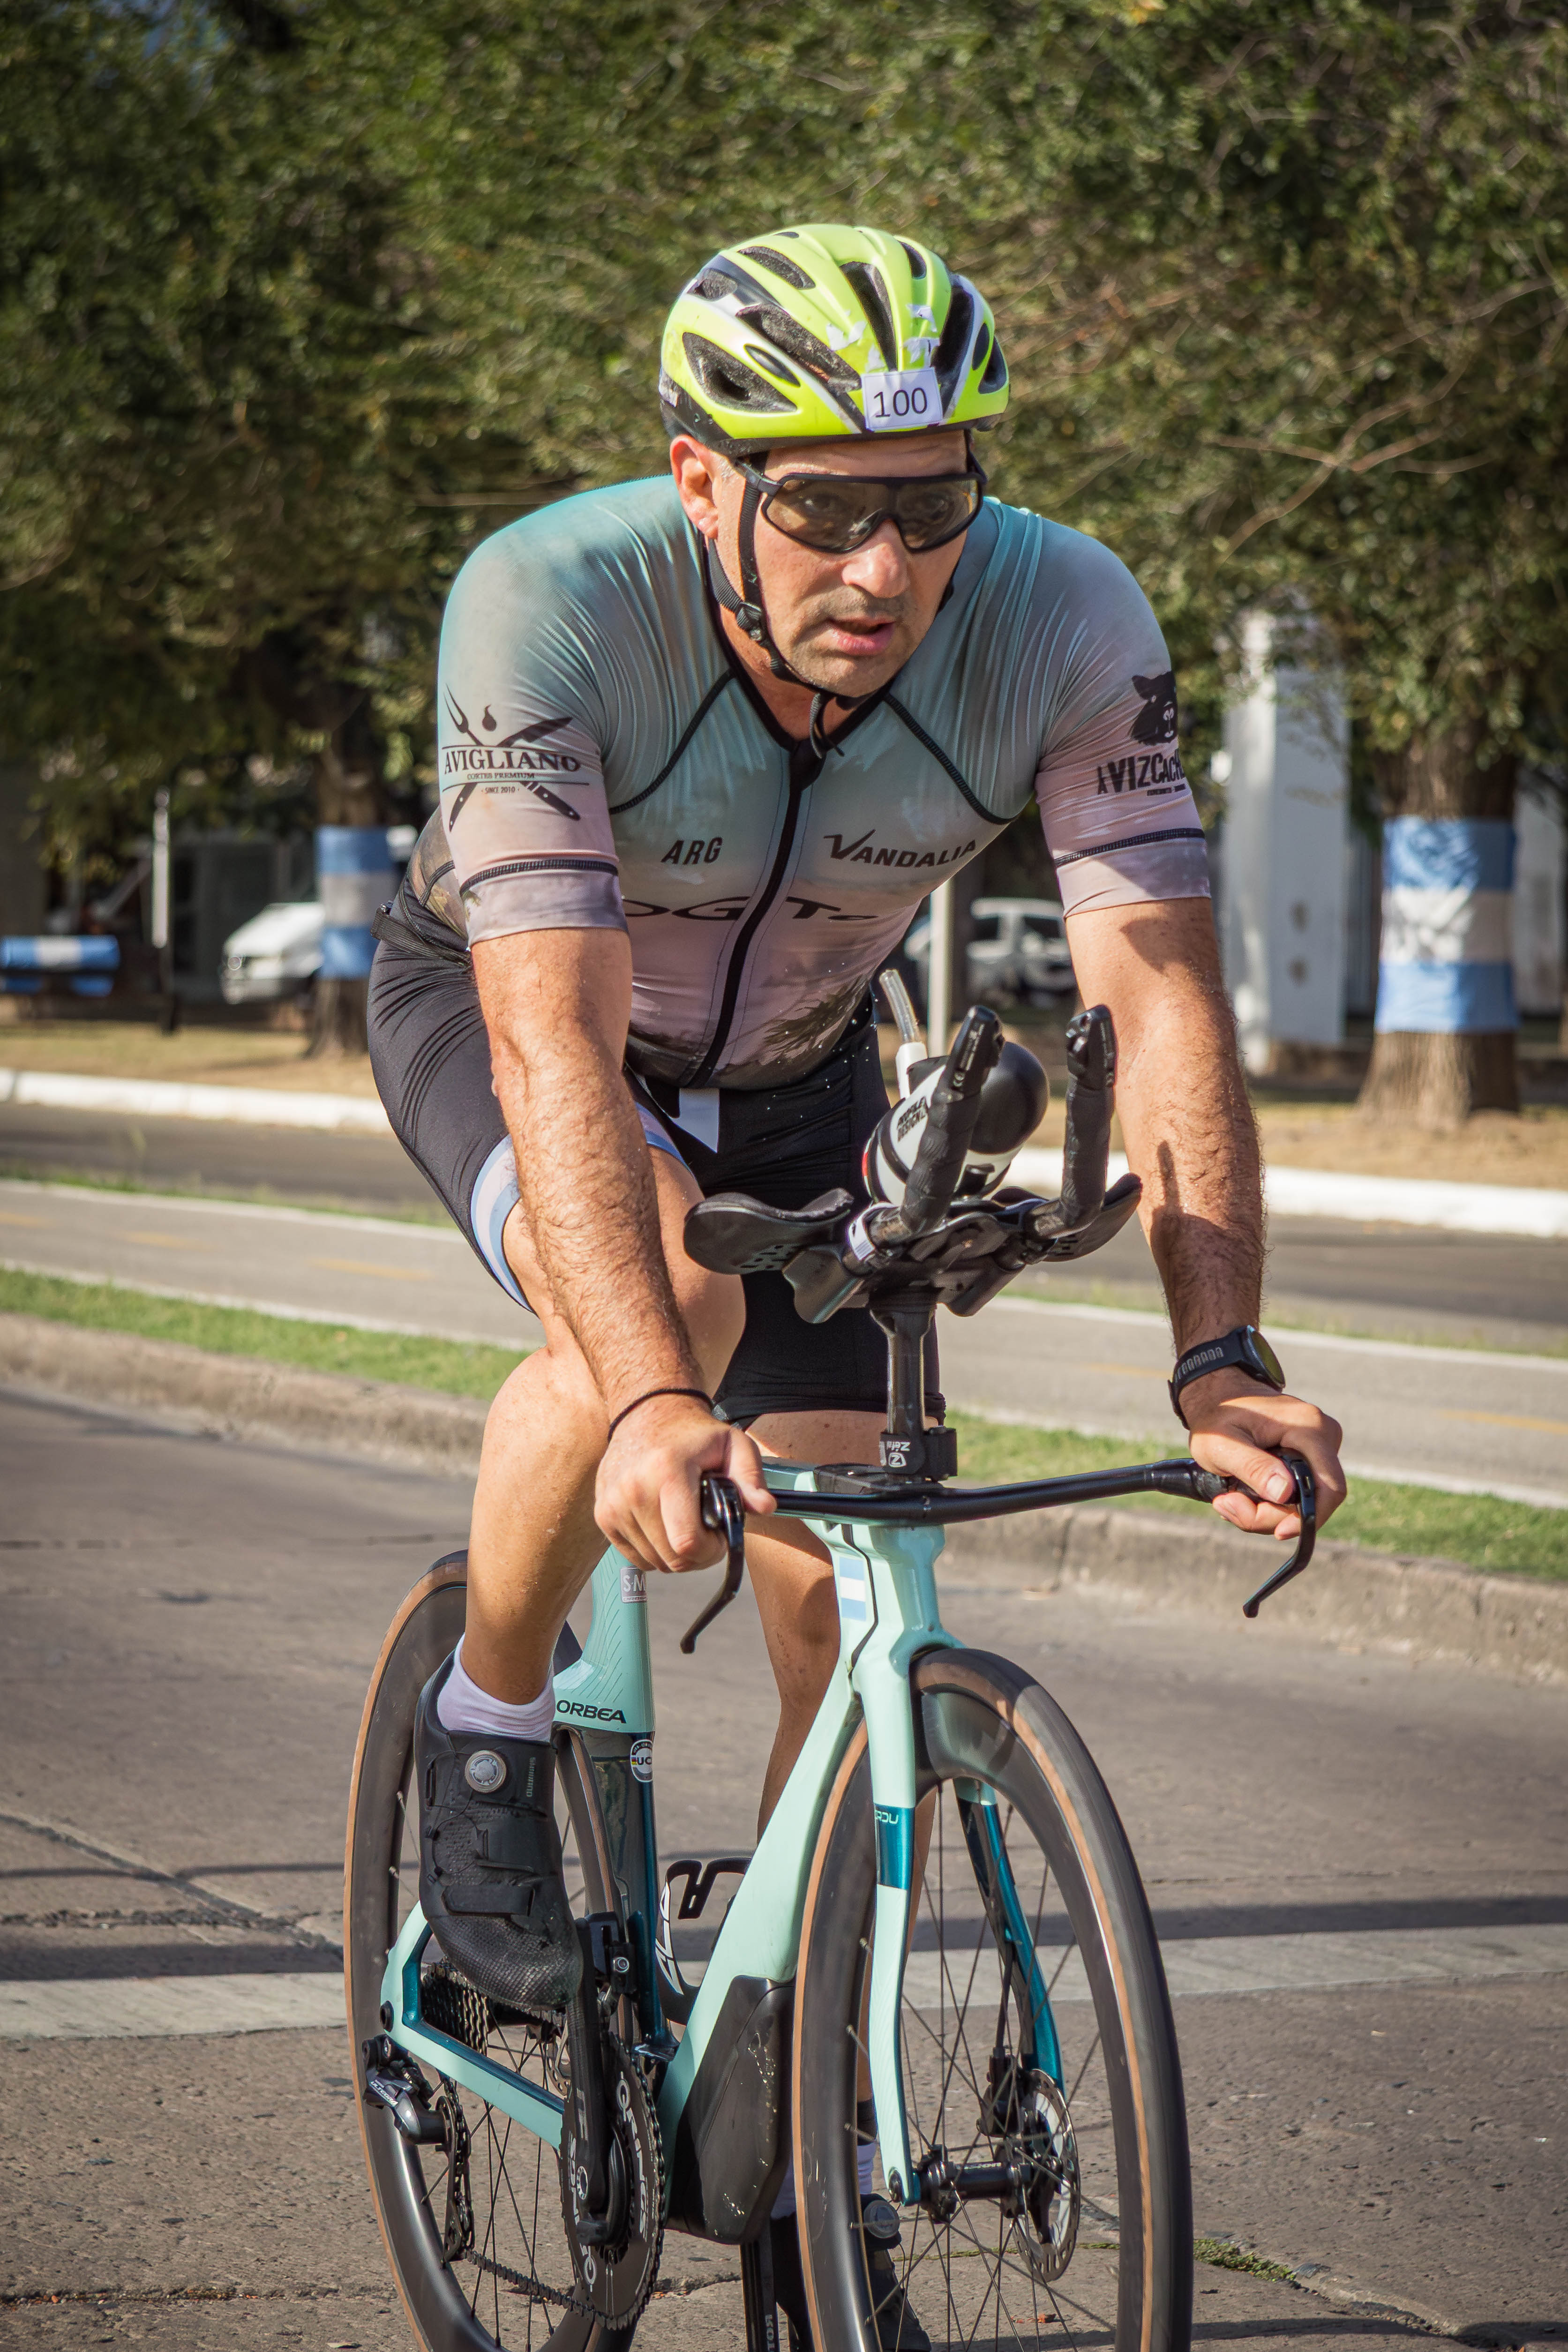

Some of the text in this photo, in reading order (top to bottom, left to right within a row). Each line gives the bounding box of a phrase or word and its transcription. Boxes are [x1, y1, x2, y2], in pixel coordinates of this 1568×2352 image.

[874, 387, 928, 418] 100
[444, 749, 581, 774] AVIGLIANO
[660, 837, 723, 865] ARG
[556, 1700, 627, 1724] ORBEA
